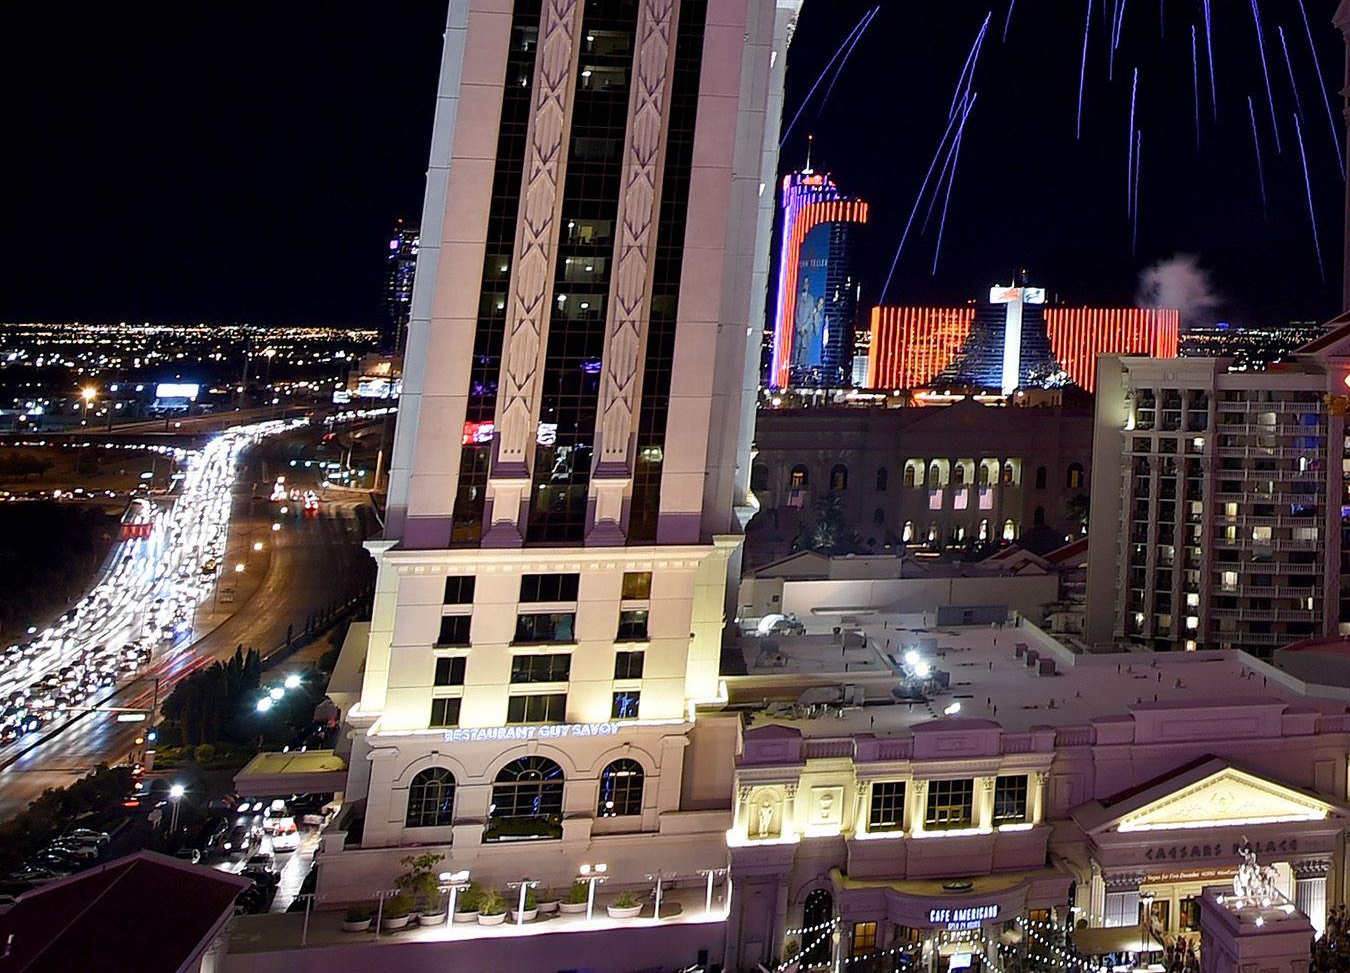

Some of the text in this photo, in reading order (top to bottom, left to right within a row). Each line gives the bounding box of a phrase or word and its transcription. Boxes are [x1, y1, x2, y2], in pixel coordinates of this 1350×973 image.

[444, 722, 620, 743] RESTAURANT GUY SAVOY
[1145, 843, 1223, 861] CAESARS
[930, 905, 998, 922] CAFE AMERICANO
